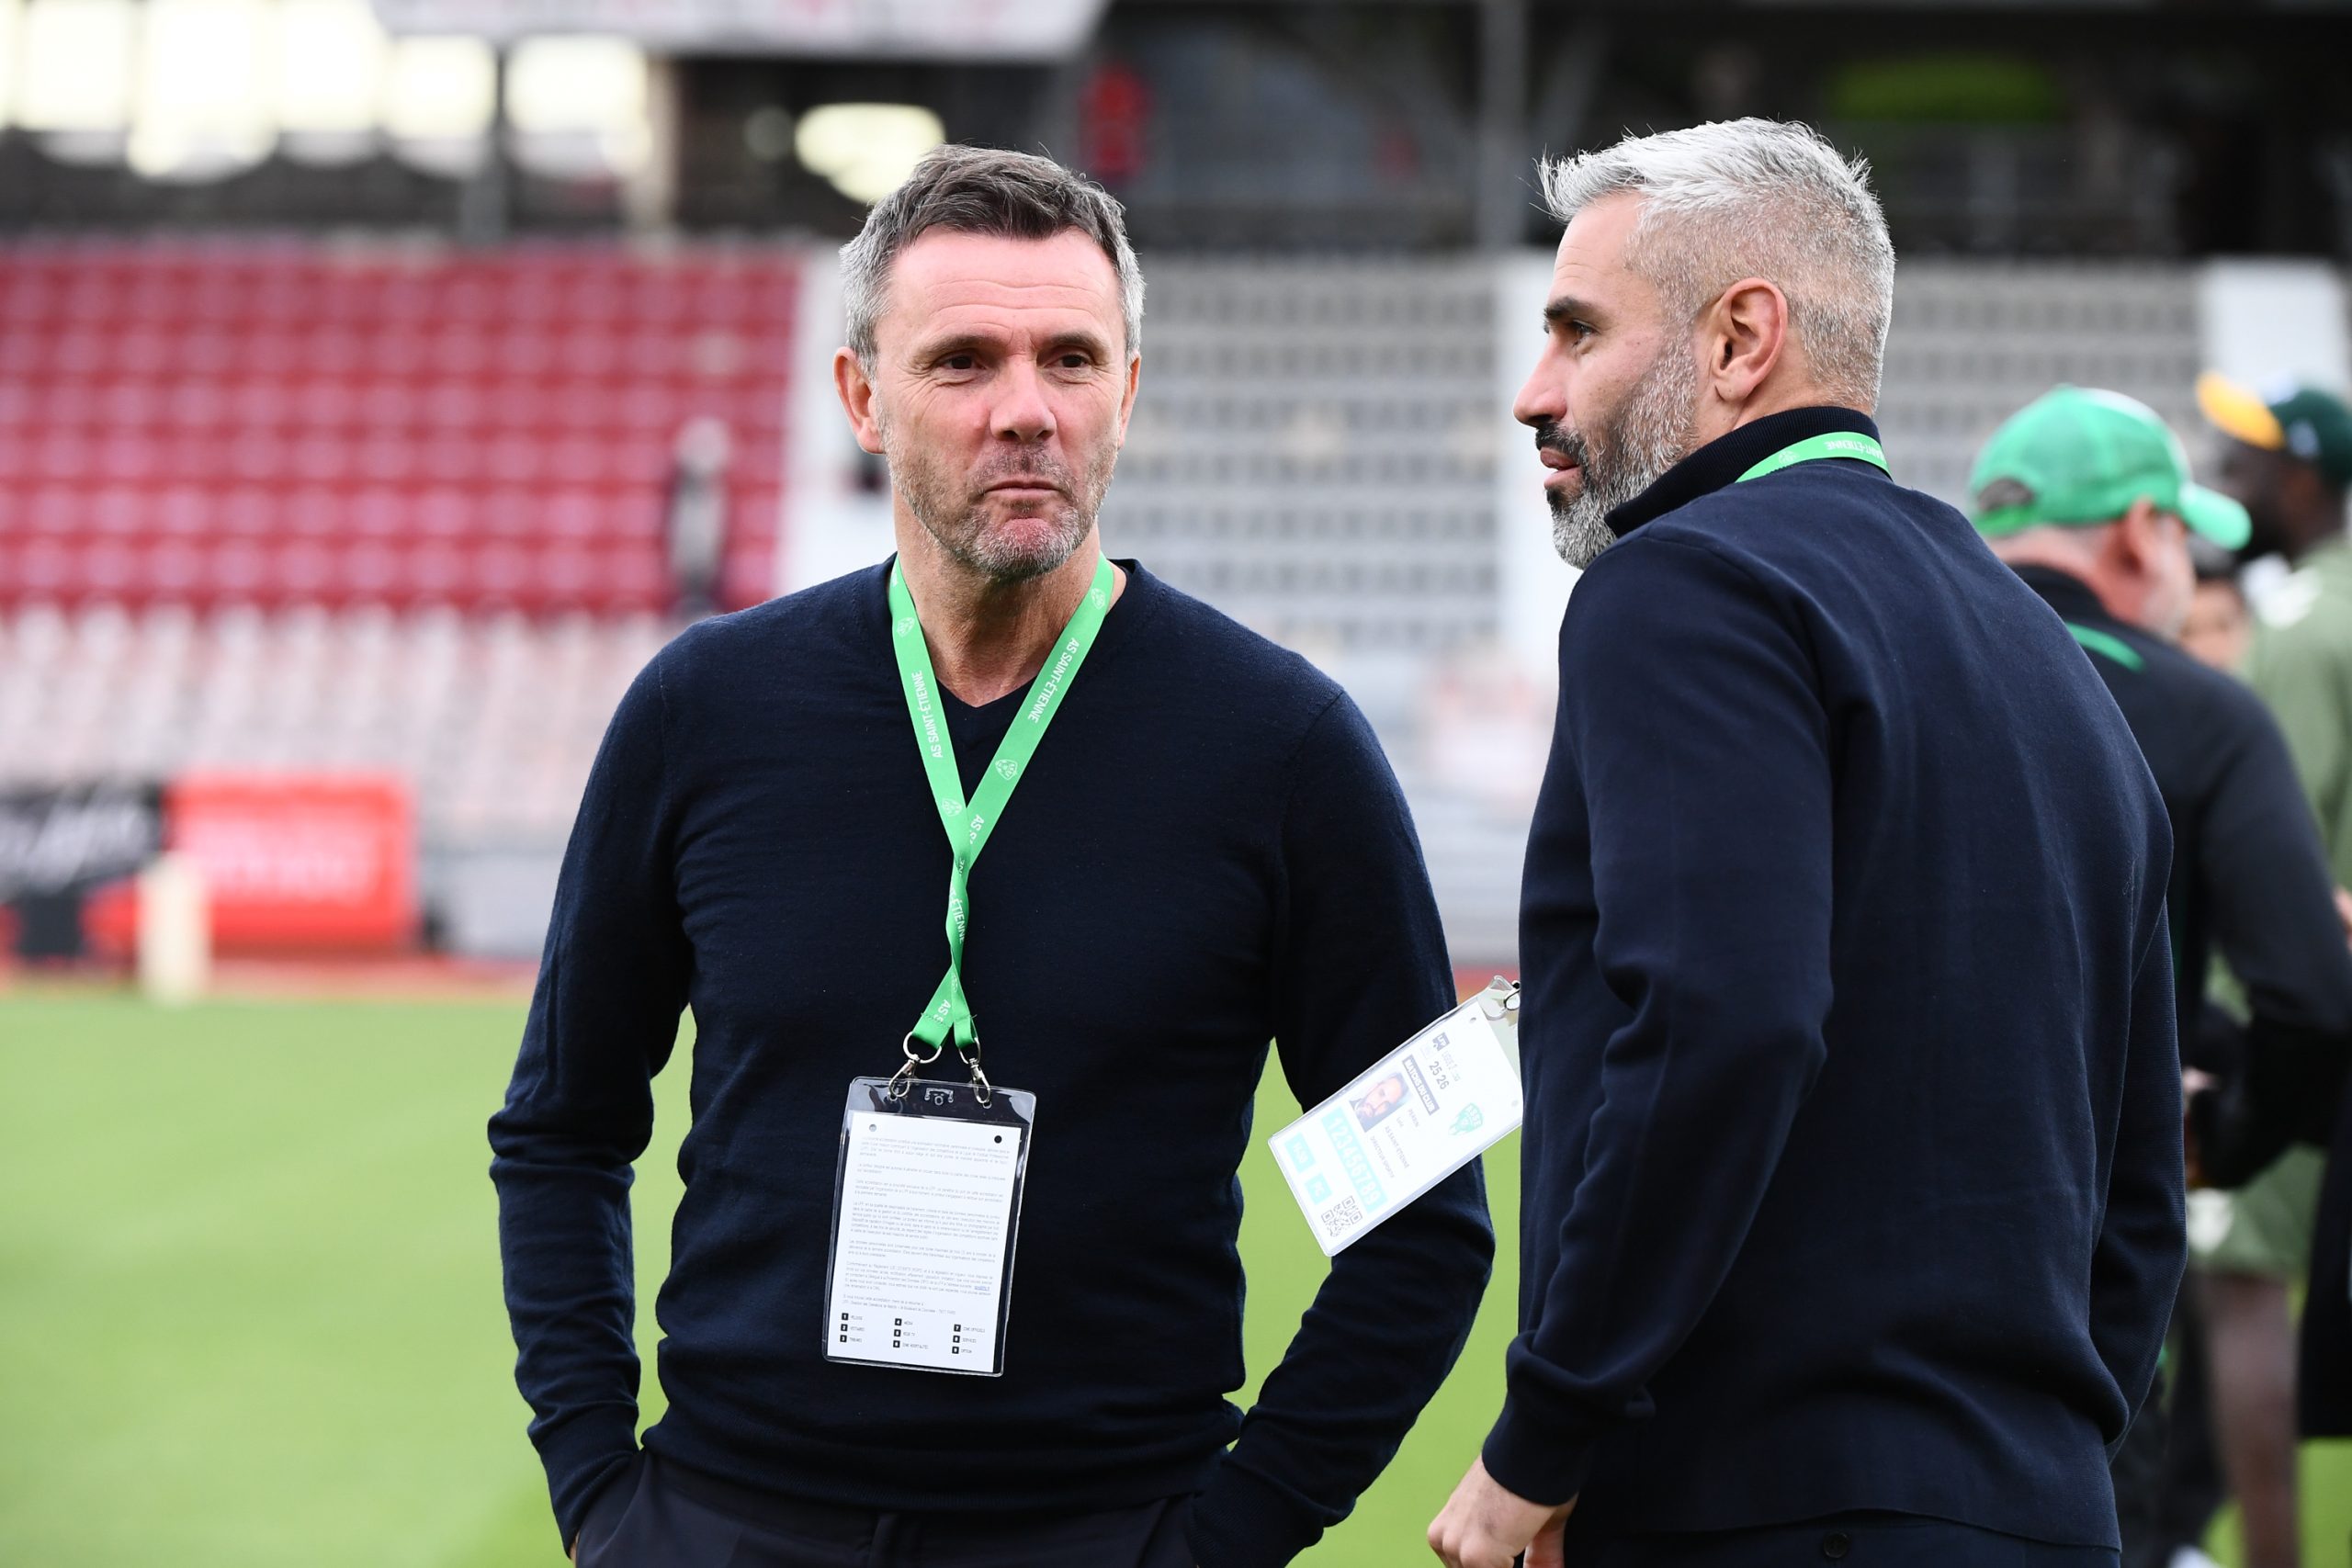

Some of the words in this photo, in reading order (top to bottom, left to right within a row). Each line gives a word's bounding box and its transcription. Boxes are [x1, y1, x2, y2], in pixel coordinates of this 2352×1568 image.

[1066, 637, 1080, 654] AS
[1027, 652, 1073, 724] SAINT-ÉTIENNE
[911, 670, 940, 743] SAINT-ÉTIENNE
[931, 744, 944, 758] AS
[970, 814, 985, 831] AS
[938, 998, 952, 1016] AS
[1403, 1058, 1422, 1086] MATCHS
[1429, 1060, 1442, 1076] 25
[1417, 1084, 1427, 1095] DU
[1435, 1073, 1450, 1089] 26
[1421, 1093, 1435, 1111] CLUB
[1326, 1115, 1383, 1206] 123456789
